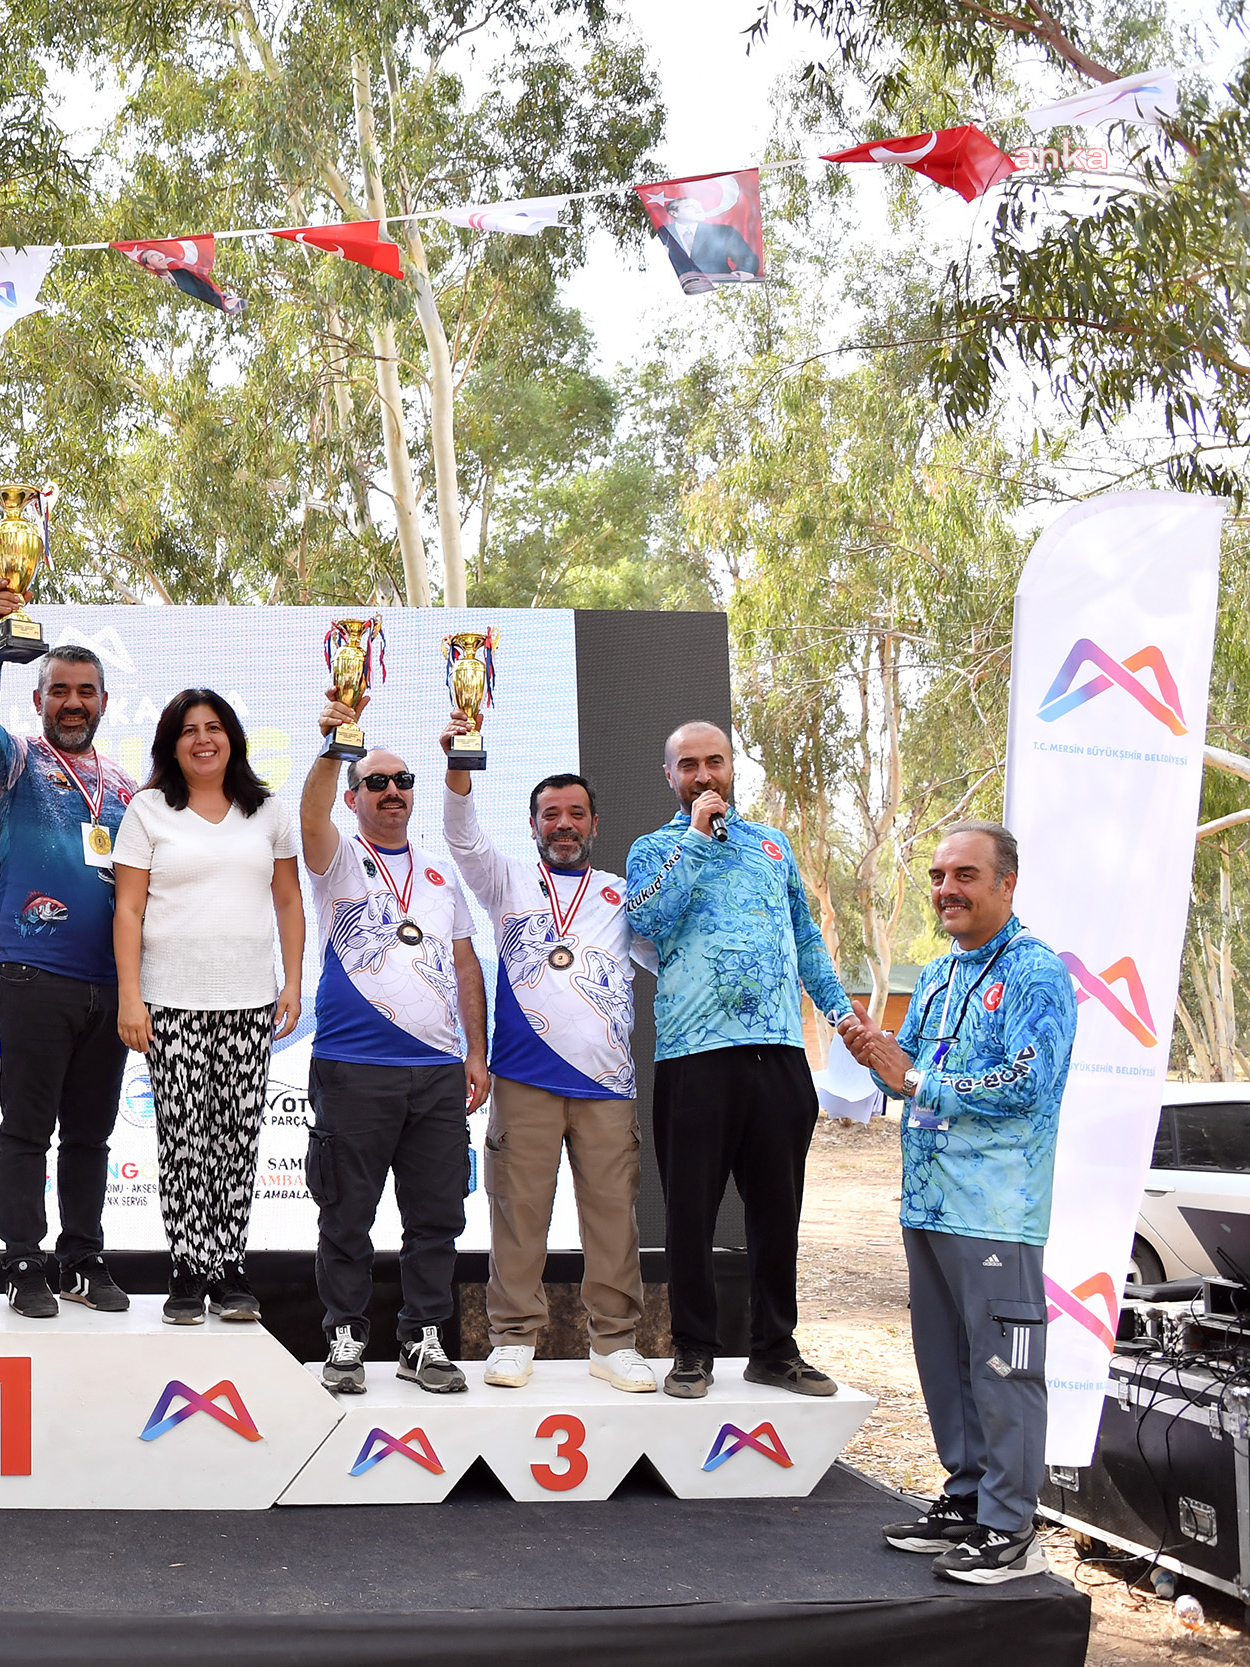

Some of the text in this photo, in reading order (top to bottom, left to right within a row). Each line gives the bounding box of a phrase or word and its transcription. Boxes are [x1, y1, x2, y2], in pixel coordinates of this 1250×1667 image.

[1033, 741, 1188, 766] T.C. MERSİN BÜYÜKŞEHİR BELEDİYESİ
[1068, 1061, 1156, 1077] ÜYÜKŞEHİR BELEDİYESİ
[131, 1183, 158, 1194] AKSES
[263, 1190, 311, 1199] AMBALA
[529, 1413, 589, 1491] 3
